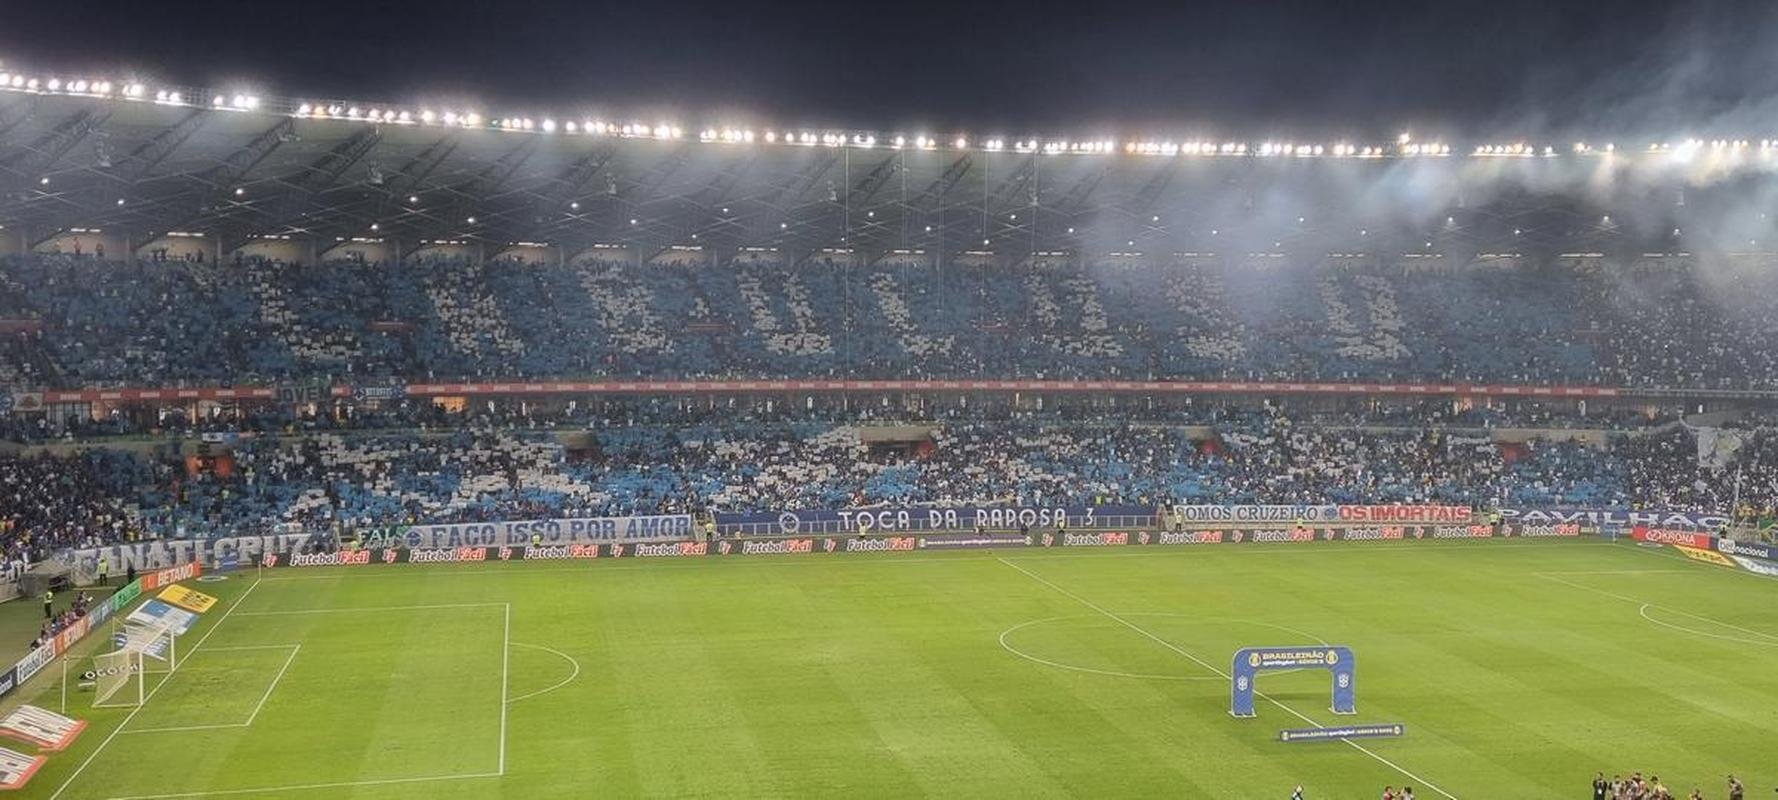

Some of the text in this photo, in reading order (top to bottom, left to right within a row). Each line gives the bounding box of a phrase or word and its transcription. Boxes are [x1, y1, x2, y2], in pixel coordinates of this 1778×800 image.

[838, 508, 1095, 530] TOCA DA RAPOSA 3
[1176, 505, 1318, 520] SOMOS CRUZEIRO
[1340, 506, 1471, 520] OS IMORTAIS
[506, 521, 560, 544] ISSO
[570, 519, 616, 541] POR
[624, 516, 689, 539] AMOR
[157, 563, 194, 587] BETANO
